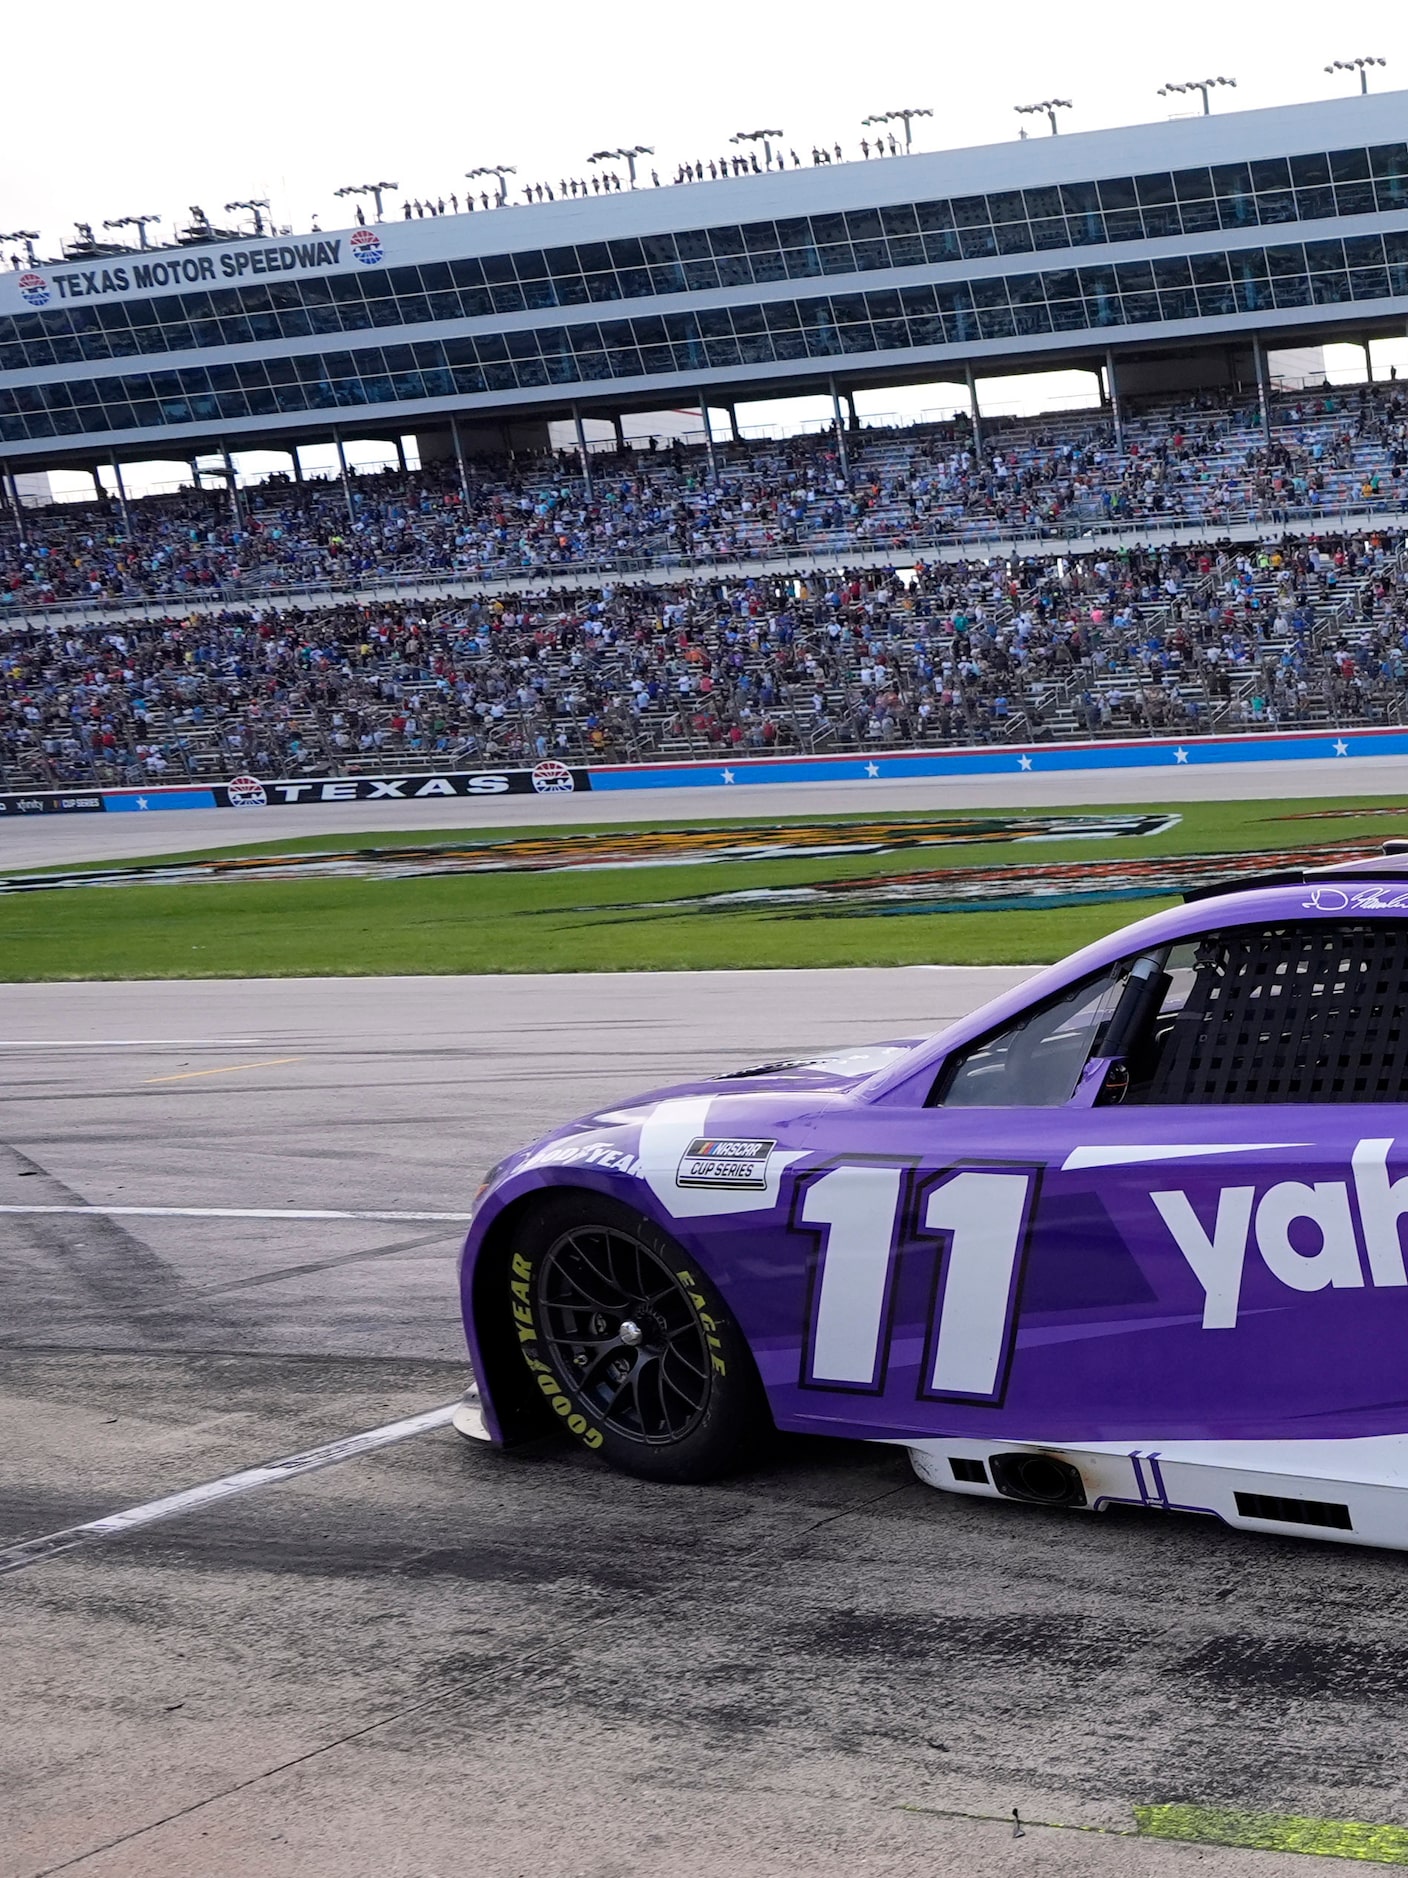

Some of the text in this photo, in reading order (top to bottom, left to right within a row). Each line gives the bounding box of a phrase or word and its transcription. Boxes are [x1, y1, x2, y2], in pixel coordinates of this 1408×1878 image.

[52, 239, 341, 298] TEXAS MOTOR SPEEDWAY
[275, 775, 510, 802] TEXAS
[690, 1161, 754, 1178] CUP SERIES
[712, 1142, 763, 1156] NASCAR
[797, 1160, 1038, 1400] 11
[511, 1252, 604, 1449] GOODYEAR
[676, 1270, 726, 1376] EAGLE
